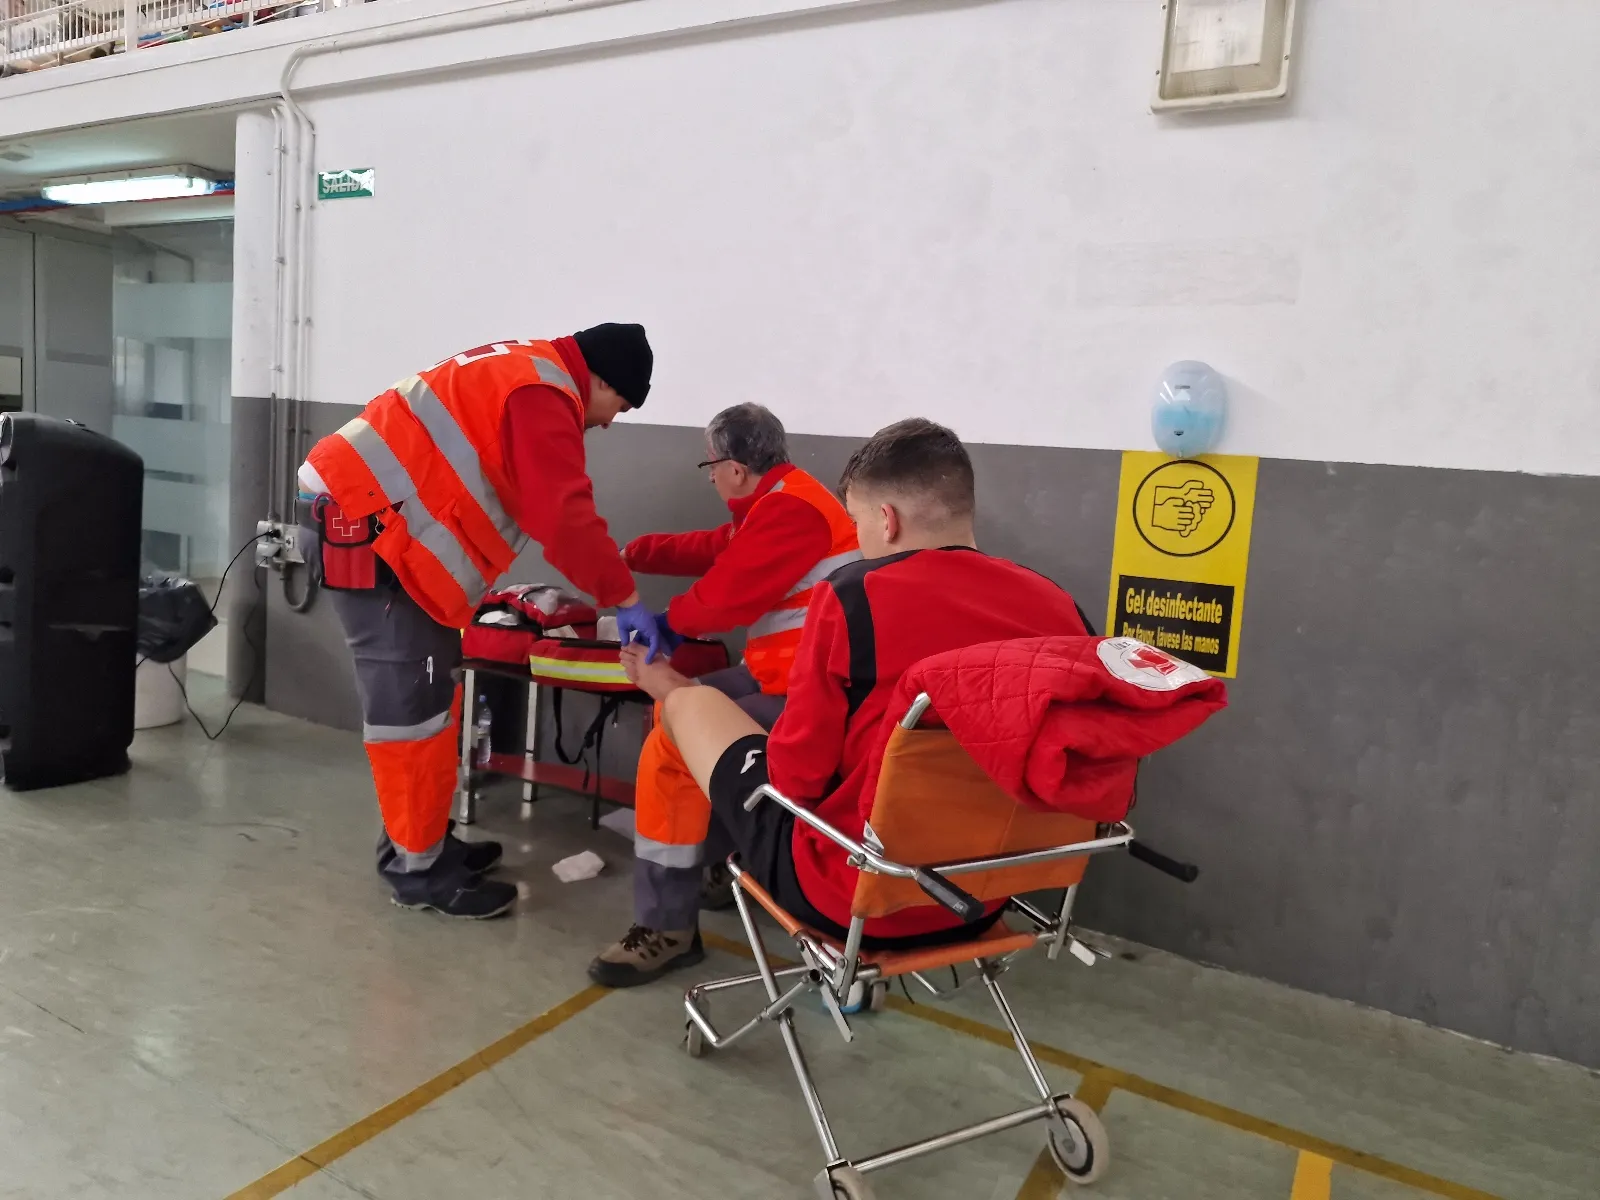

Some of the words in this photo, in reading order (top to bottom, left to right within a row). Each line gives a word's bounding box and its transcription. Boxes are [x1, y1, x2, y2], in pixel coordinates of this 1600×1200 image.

[322, 176, 364, 194] SALID
[1126, 588, 1145, 614] Gel
[1146, 590, 1223, 624] desinfectante
[1181, 630, 1193, 651] las
[1194, 636, 1220, 655] manos
